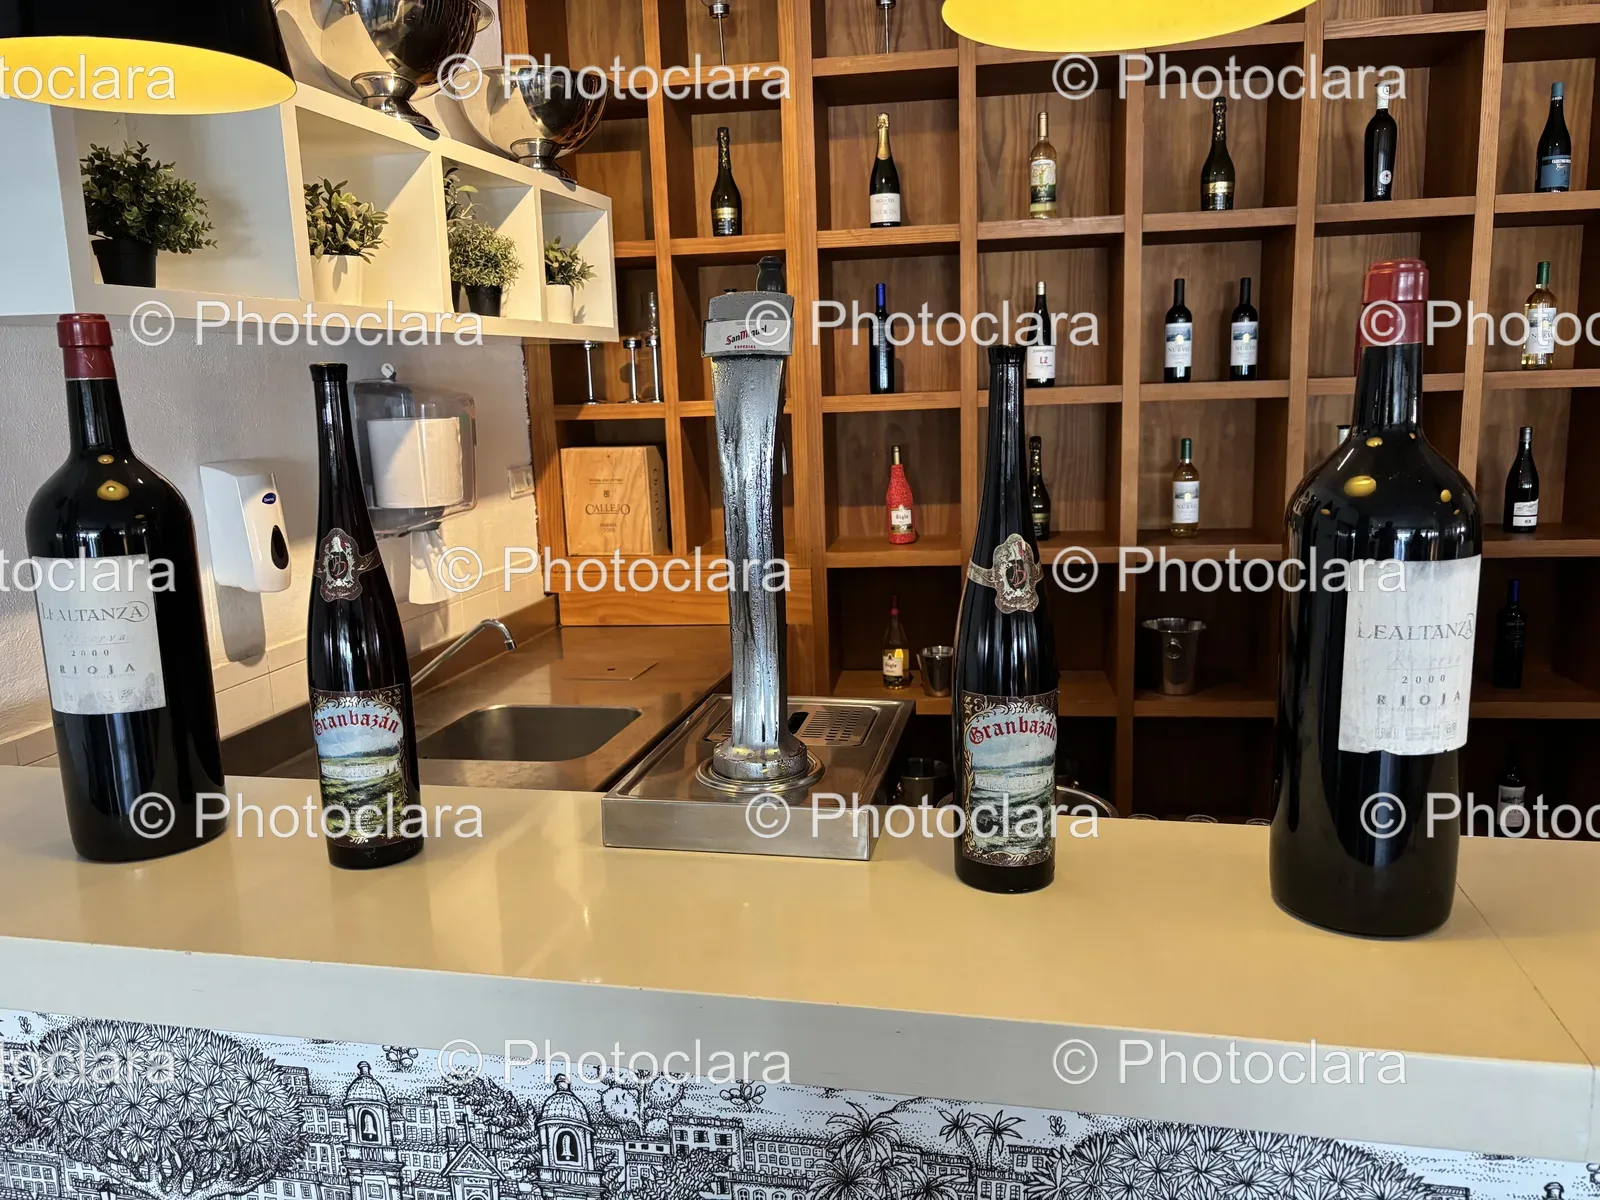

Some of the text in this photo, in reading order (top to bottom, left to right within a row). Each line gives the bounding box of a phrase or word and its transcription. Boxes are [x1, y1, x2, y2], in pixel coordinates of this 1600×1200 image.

[1039, 356, 1049, 364] LZ
[585, 504, 631, 516] CALLEJO
[1357, 612, 1475, 641] LEALTANZA
[71, 648, 110, 657] 2000
[59, 663, 136, 675] RIOJA
[1400, 673, 1447, 685] 2000
[1376, 691, 1461, 706] RIOJA
[314, 709, 401, 737] Granbazán
[969, 716, 1058, 744] Granbazán
